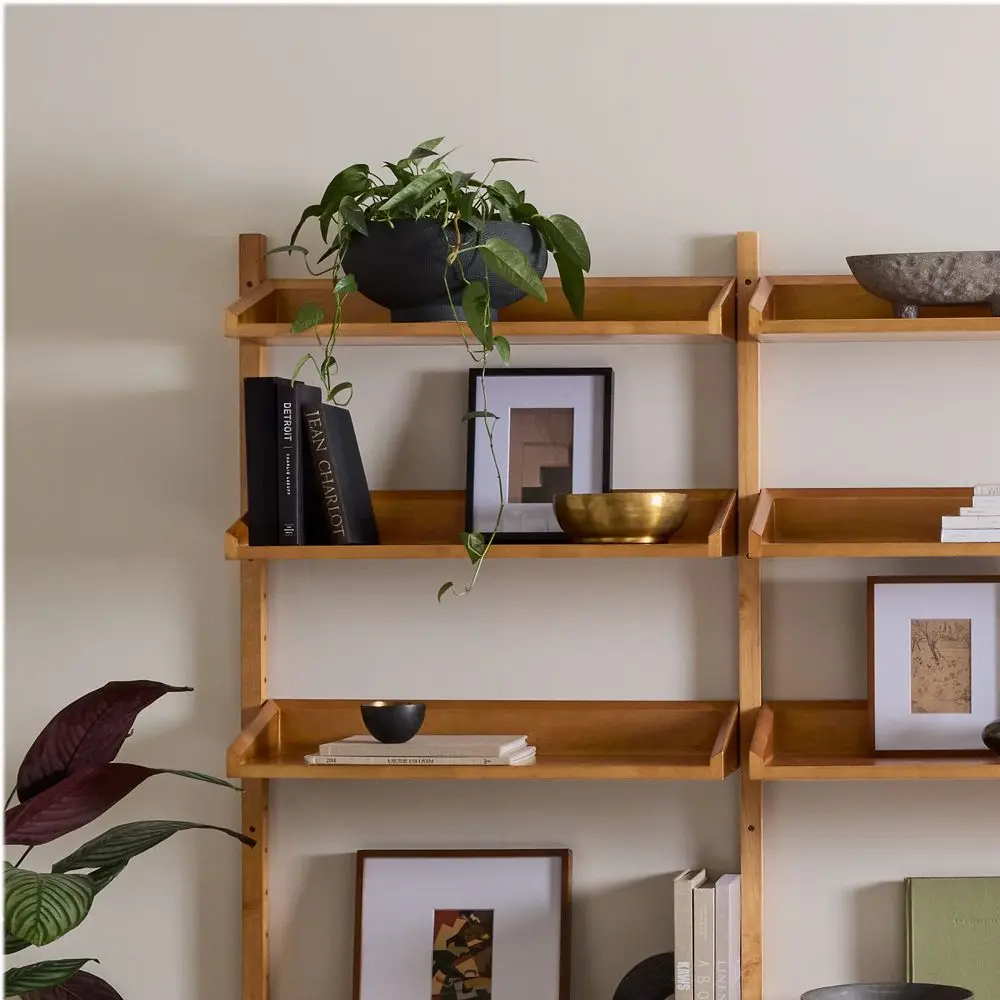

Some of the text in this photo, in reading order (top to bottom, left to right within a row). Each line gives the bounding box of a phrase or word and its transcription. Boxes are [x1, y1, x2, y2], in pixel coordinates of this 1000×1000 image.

[283, 402, 293, 442] DETROIT
[305, 410, 345, 536] JEAN CHARLOT
[676, 961, 690, 991] KAWS
